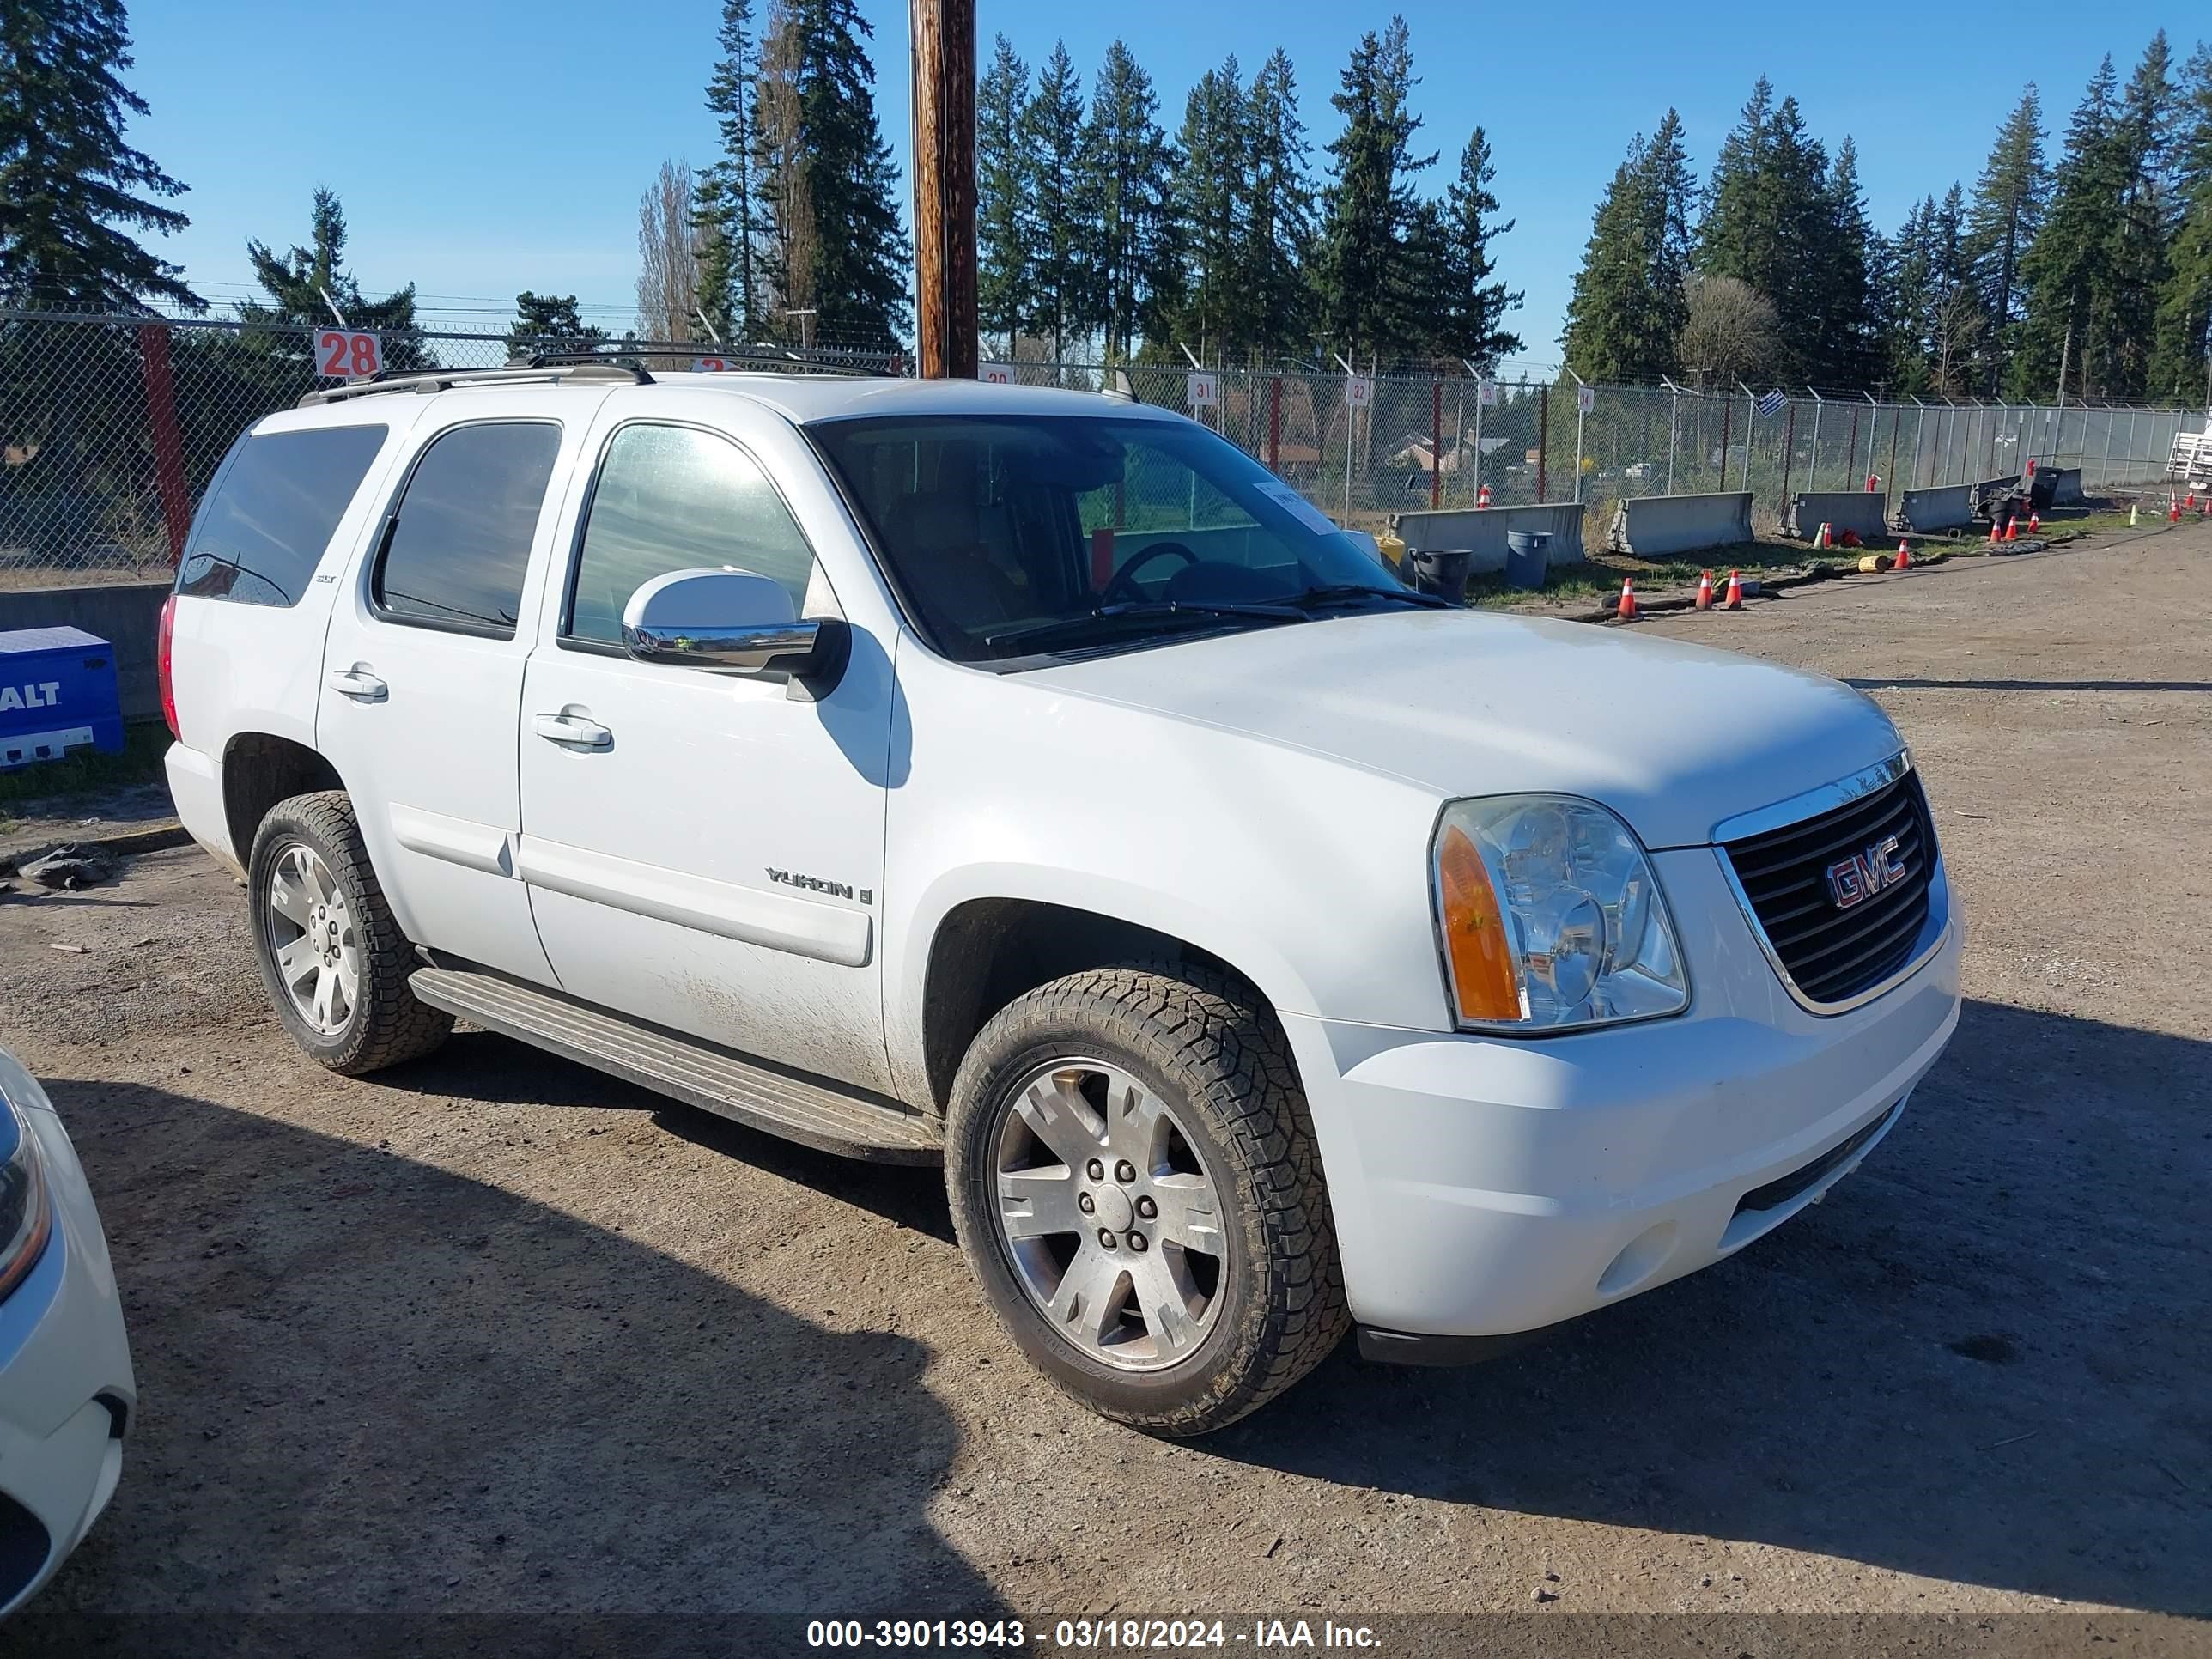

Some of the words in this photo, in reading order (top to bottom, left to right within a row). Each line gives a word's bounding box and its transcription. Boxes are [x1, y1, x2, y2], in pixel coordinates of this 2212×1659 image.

[321, 332, 377, 376] 28
[1196, 383, 1210, 399] 31
[1353, 384, 1364, 399] 32
[763, 866, 854, 900] YUKON
[1826, 835, 1906, 908] GMC
